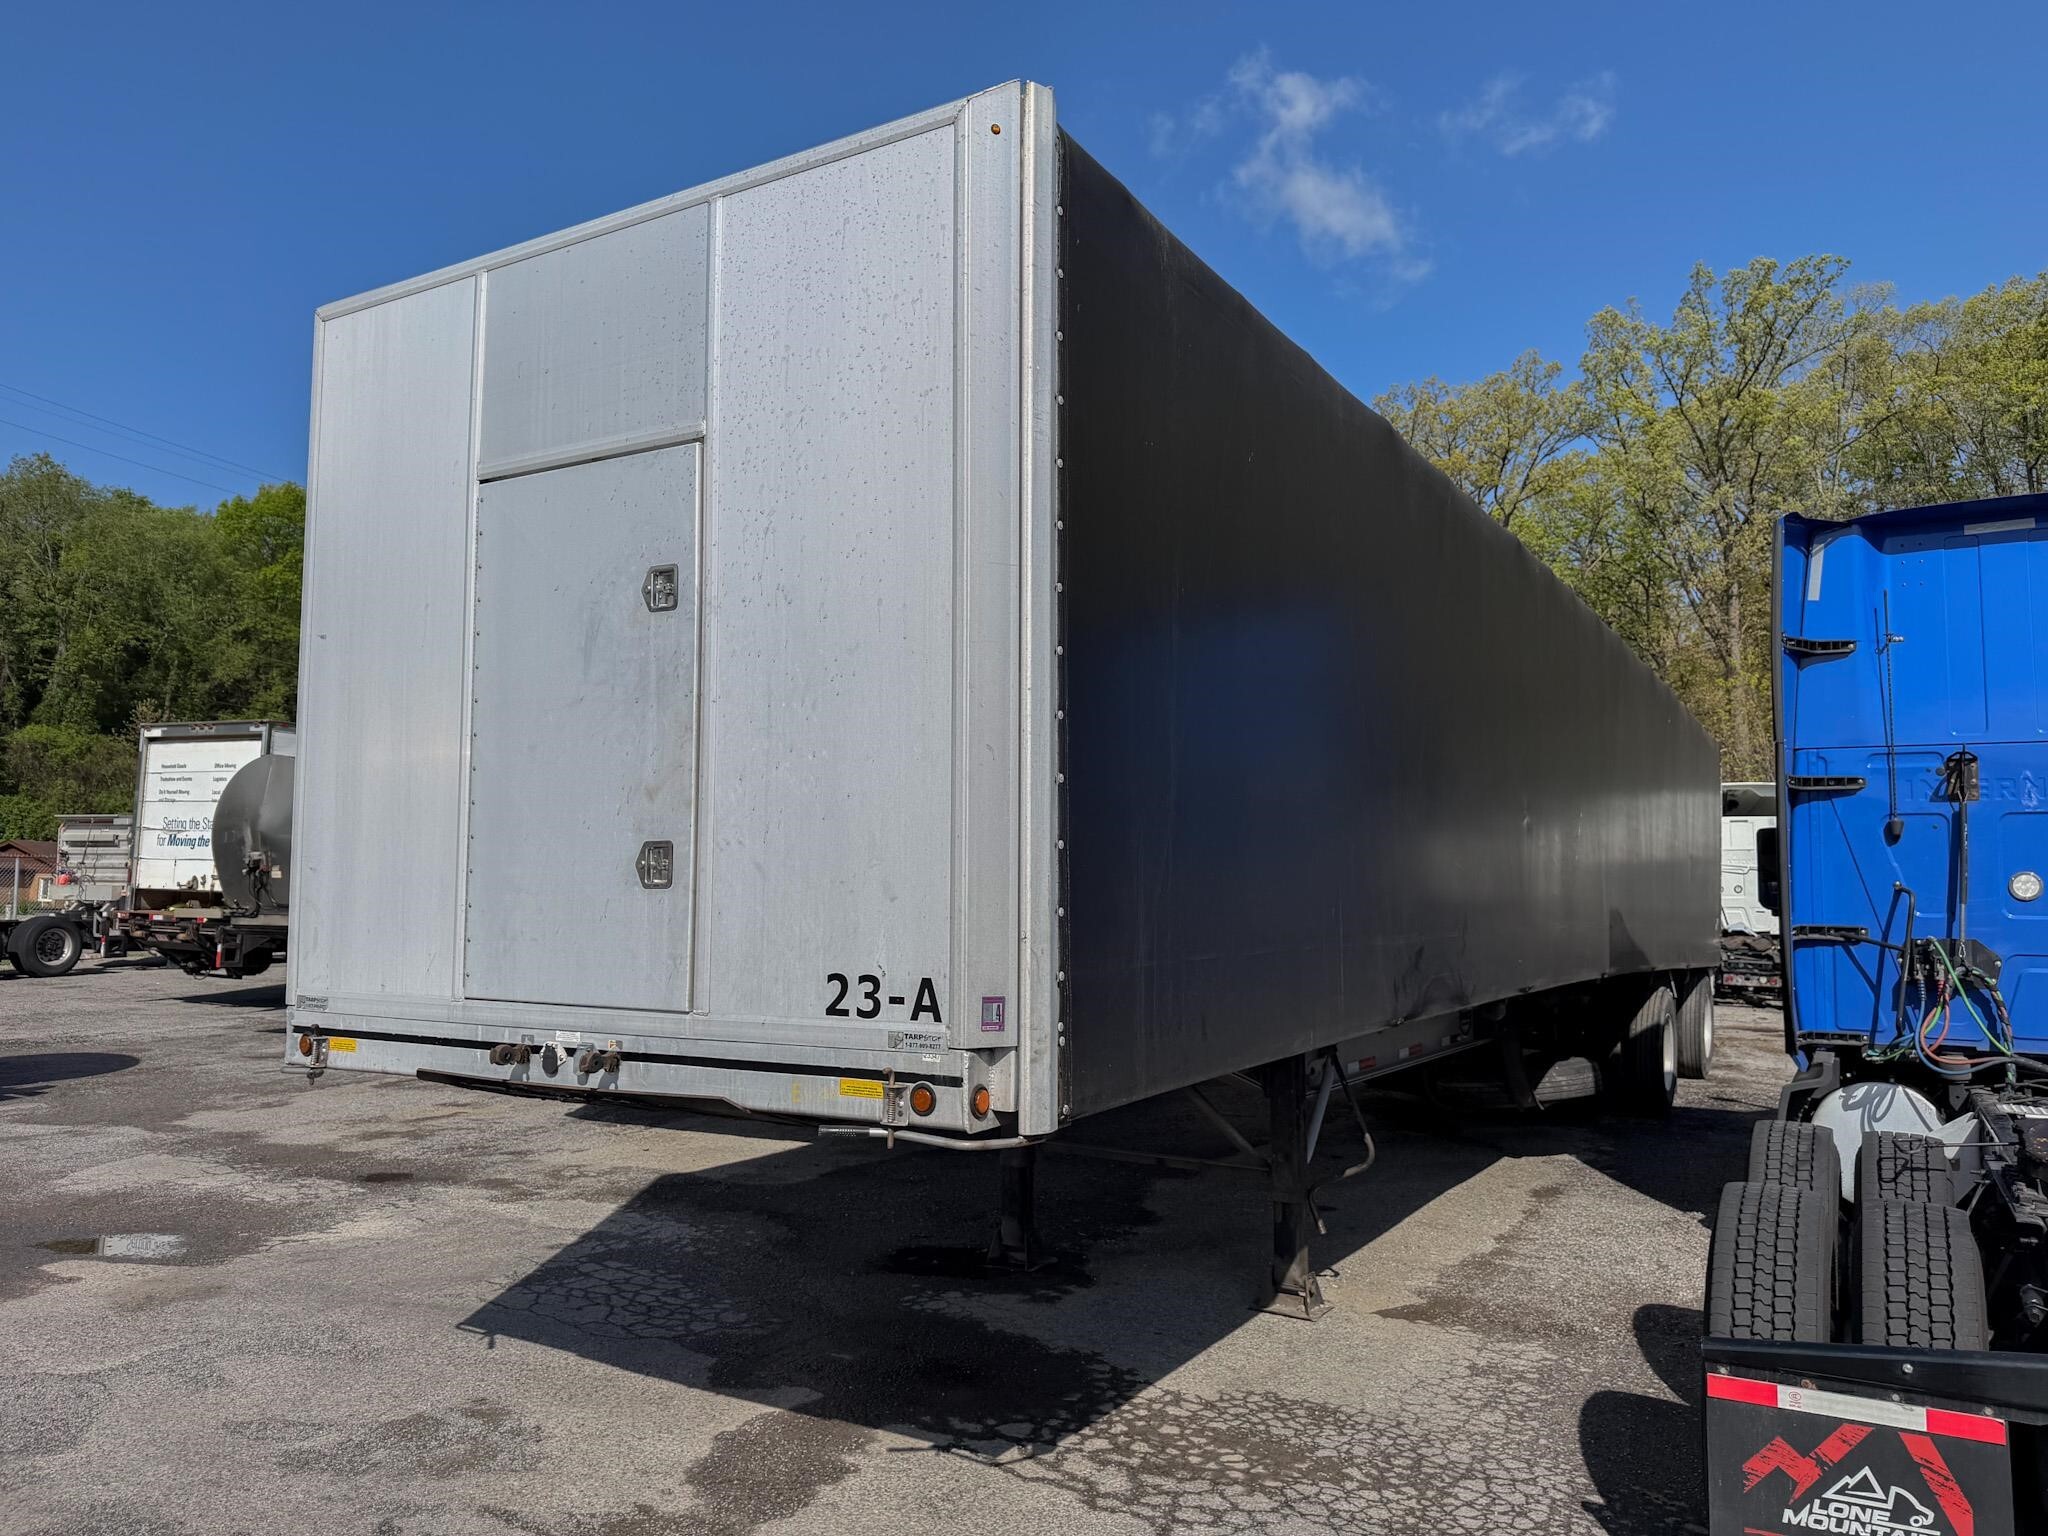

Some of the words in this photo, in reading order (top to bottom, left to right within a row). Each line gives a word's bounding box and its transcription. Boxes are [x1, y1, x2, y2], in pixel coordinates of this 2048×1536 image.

[163, 816, 187, 831] Setting
[189, 817, 200, 830] the
[157, 834, 167, 847] for
[167, 834, 197, 850] Moving
[197, 834, 210, 847] the
[825, 973, 943, 1023] 23-A
[1811, 1499, 1891, 1524] LONE
